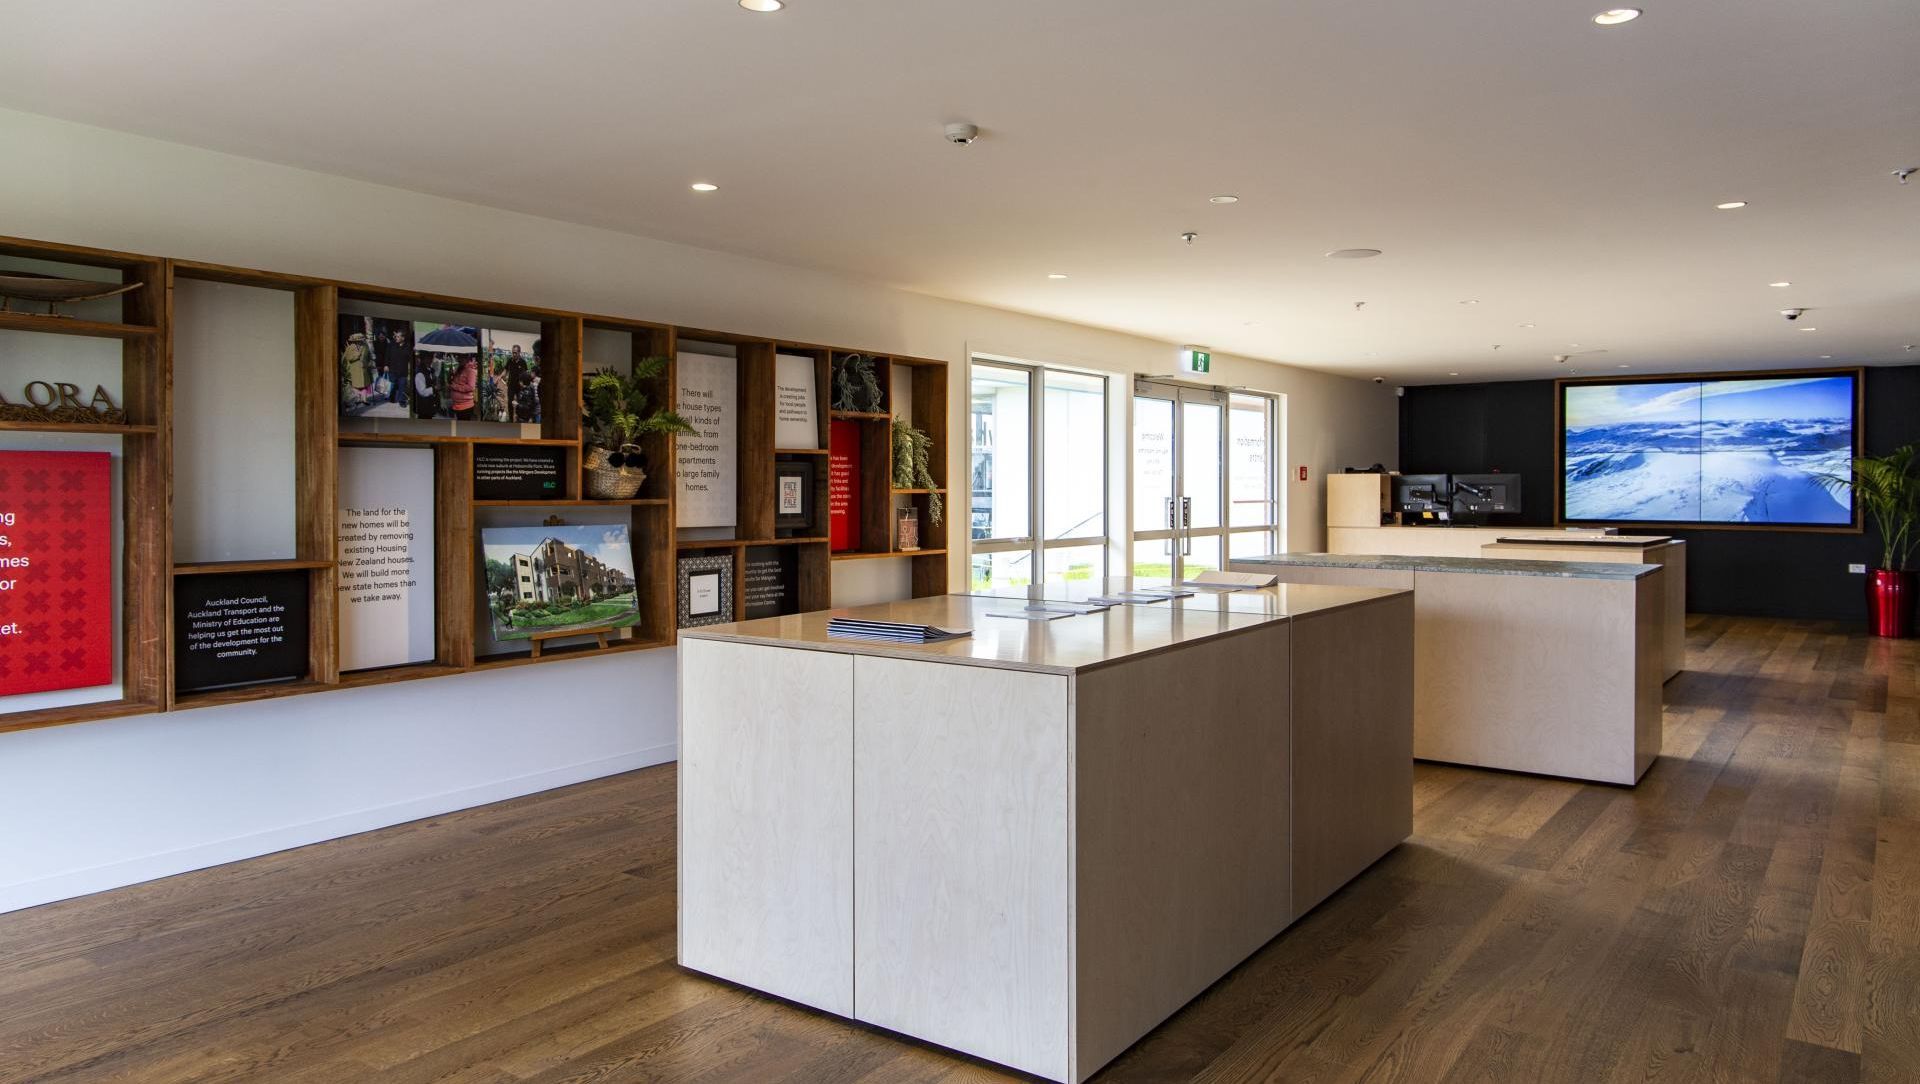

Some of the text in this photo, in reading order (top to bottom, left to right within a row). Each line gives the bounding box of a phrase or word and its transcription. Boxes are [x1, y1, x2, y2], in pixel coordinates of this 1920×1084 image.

[24, 381, 115, 412] ORA
[682, 388, 713, 398] There will
[704, 404, 721, 412] types
[695, 416, 712, 425] kinds
[676, 443, 719, 451] one-bedroom
[683, 470, 699, 479] large
[701, 470, 720, 479] family
[685, 483, 709, 491] homes.
[369, 533, 377, 542] by
[380, 532, 413, 540] removing
[344, 544, 406, 554] existing Housing
[356, 557, 385, 566] Zealand
[371, 569, 389, 577] build
[206, 598, 239, 606] Auckland
[188, 610, 221, 618] Auckland
[224, 608, 257, 616] Transport
[192, 620, 222, 628] Ministry
[233, 617, 268, 625] Education
[0, 622, 22, 634] et.
[188, 631, 215, 639] helping
[227, 629, 239, 638] get
[213, 638, 258, 648] development
[217, 649, 257, 658] community.
